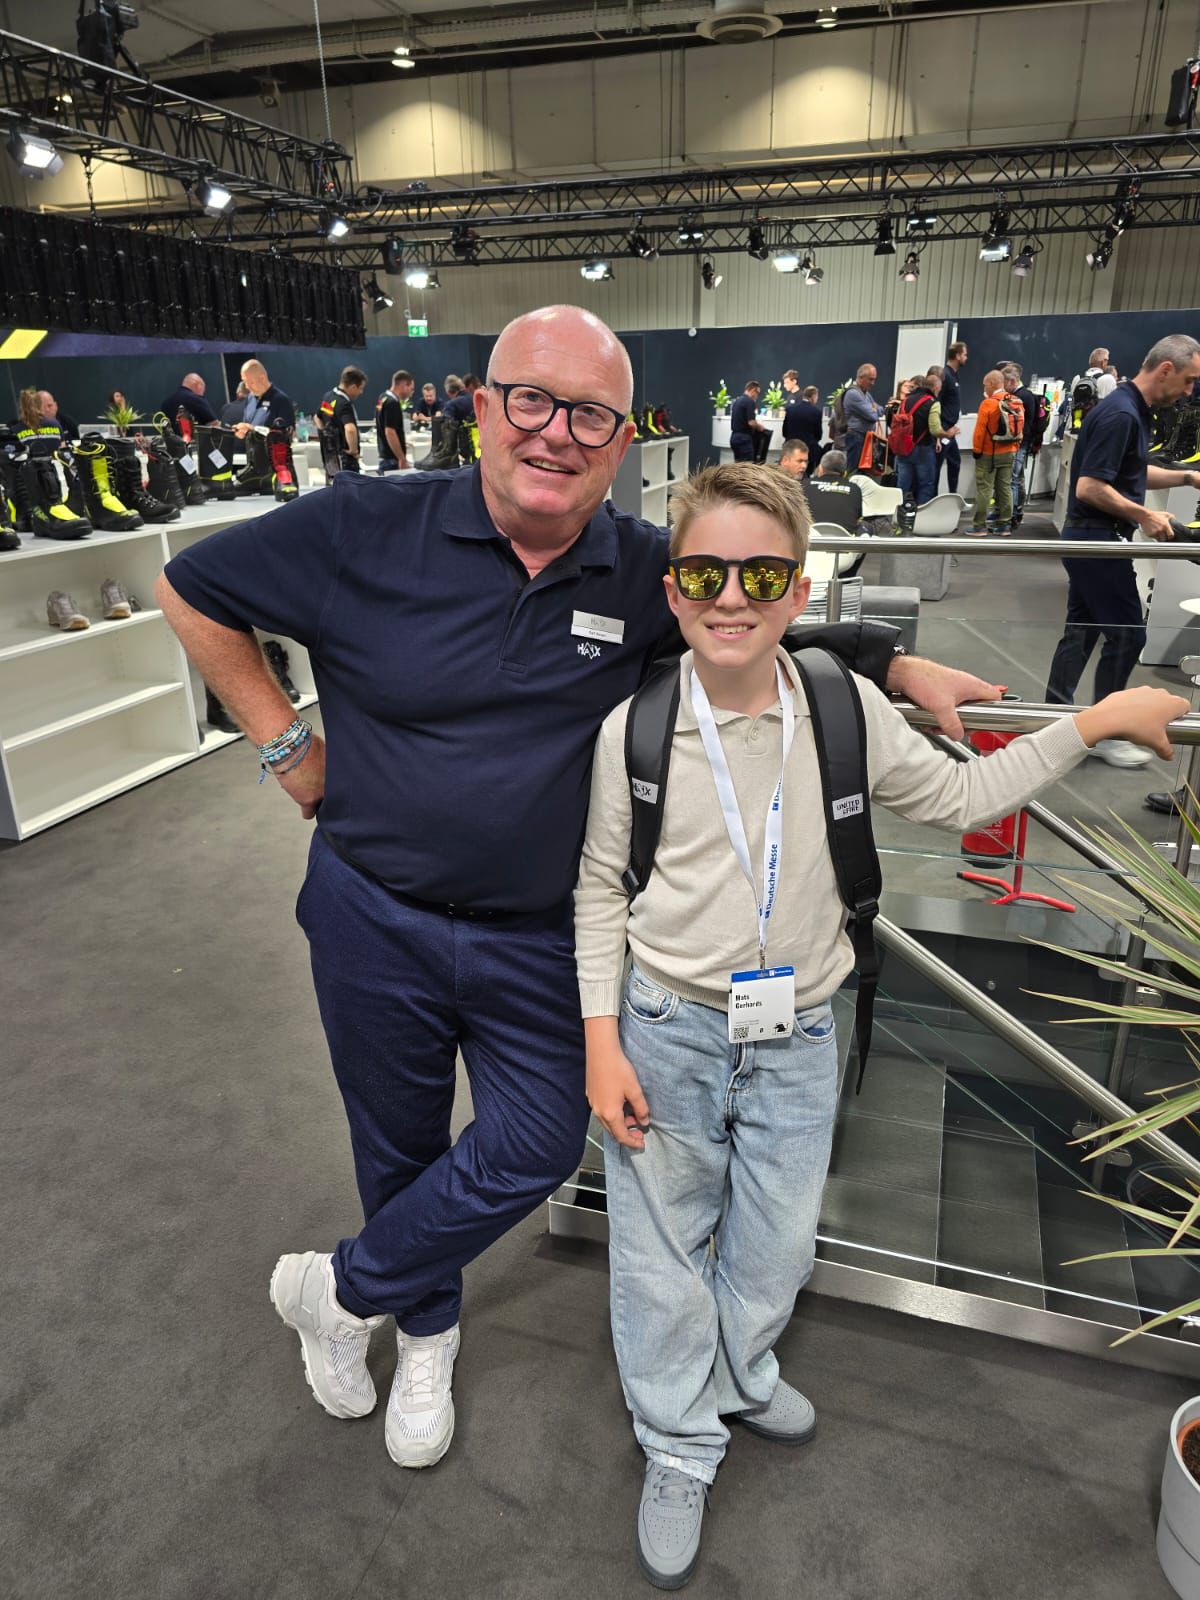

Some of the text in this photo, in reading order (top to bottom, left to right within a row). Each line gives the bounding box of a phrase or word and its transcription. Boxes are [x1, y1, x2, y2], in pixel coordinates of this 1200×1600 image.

[577, 642, 601, 659] HAIX
[766, 843, 778, 910] Deutsche Messe
